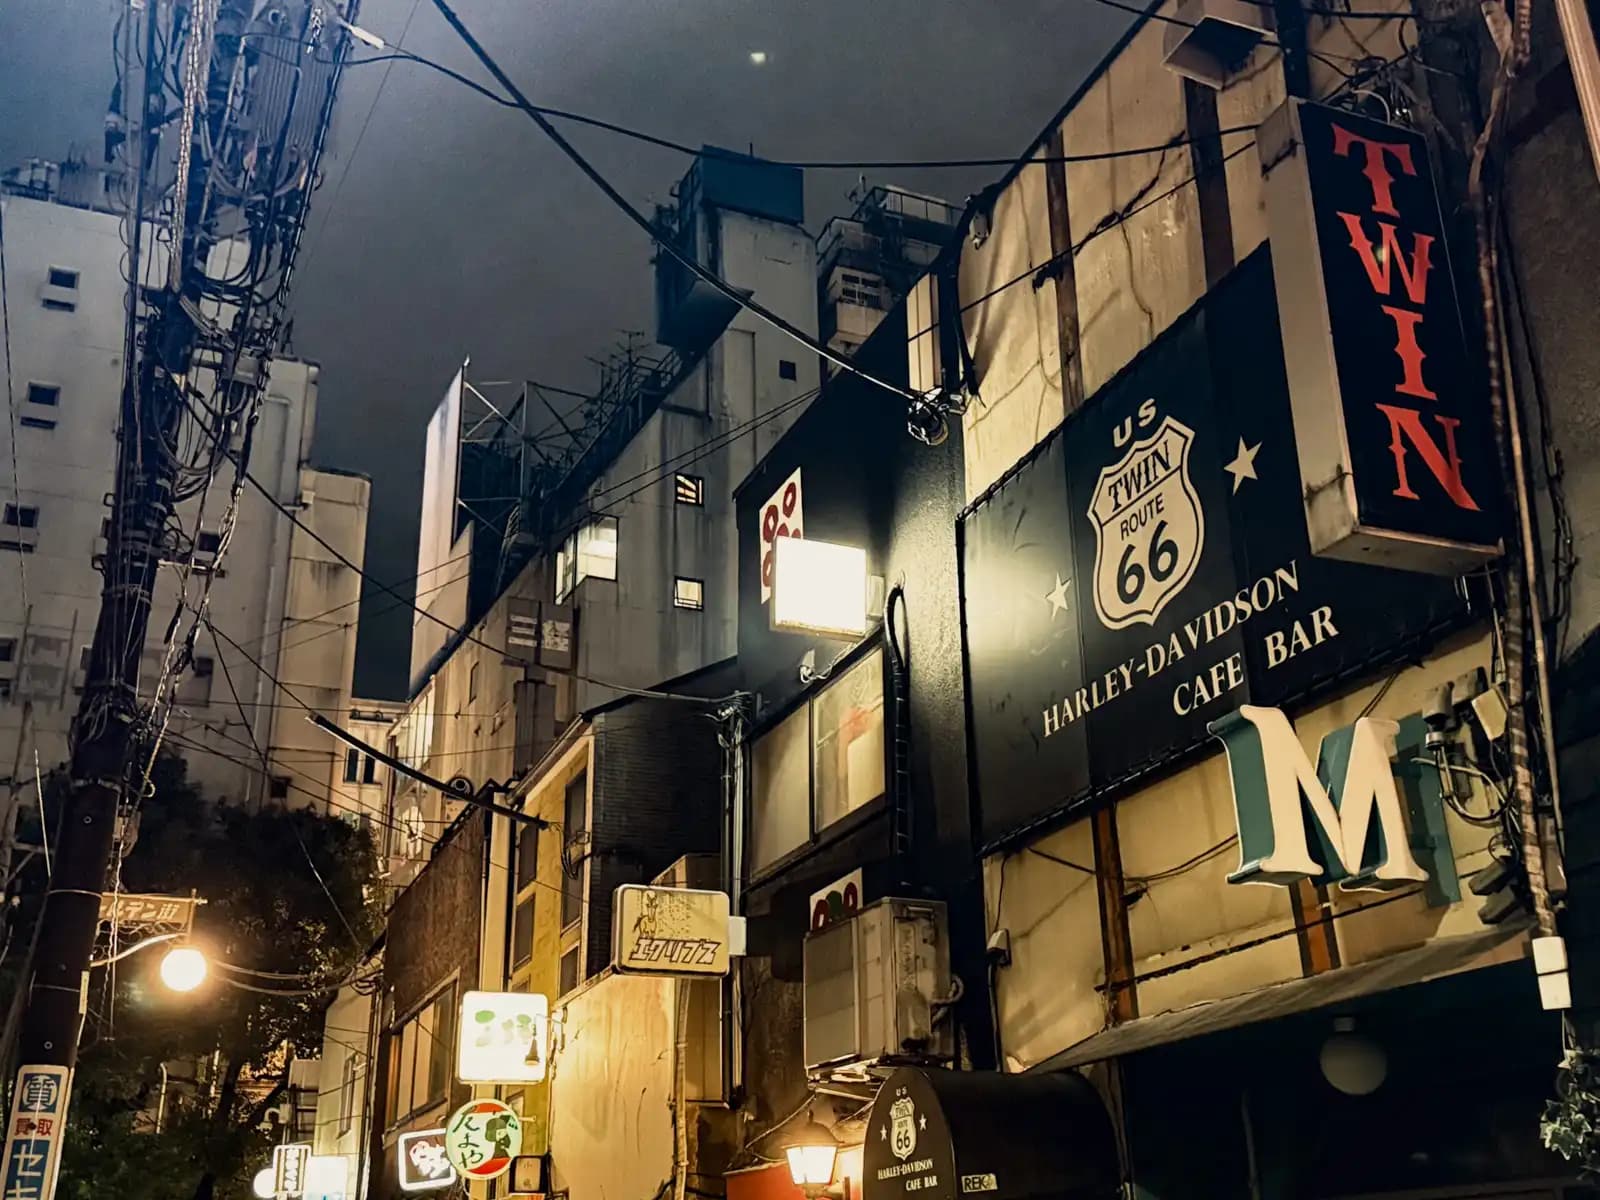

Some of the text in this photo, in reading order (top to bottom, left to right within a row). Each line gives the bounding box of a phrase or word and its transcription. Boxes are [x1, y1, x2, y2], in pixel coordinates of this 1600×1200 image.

[1331, 123, 1482, 511] TWIN
[1112, 398, 1157, 448] US
[1107, 439, 1172, 514] TWIN
[1119, 492, 1165, 541] ROUTE
[1116, 519, 1179, 605] 66
[1041, 560, 1301, 738] HARLEY-DAVIDSON
[1172, 605, 1339, 717] CAFE BAR
[878, 1159, 933, 1180] HARLEY-DAVIDSON
[896, 1130, 910, 1150] 66
[905, 1176, 938, 1191] CAFE BAR
